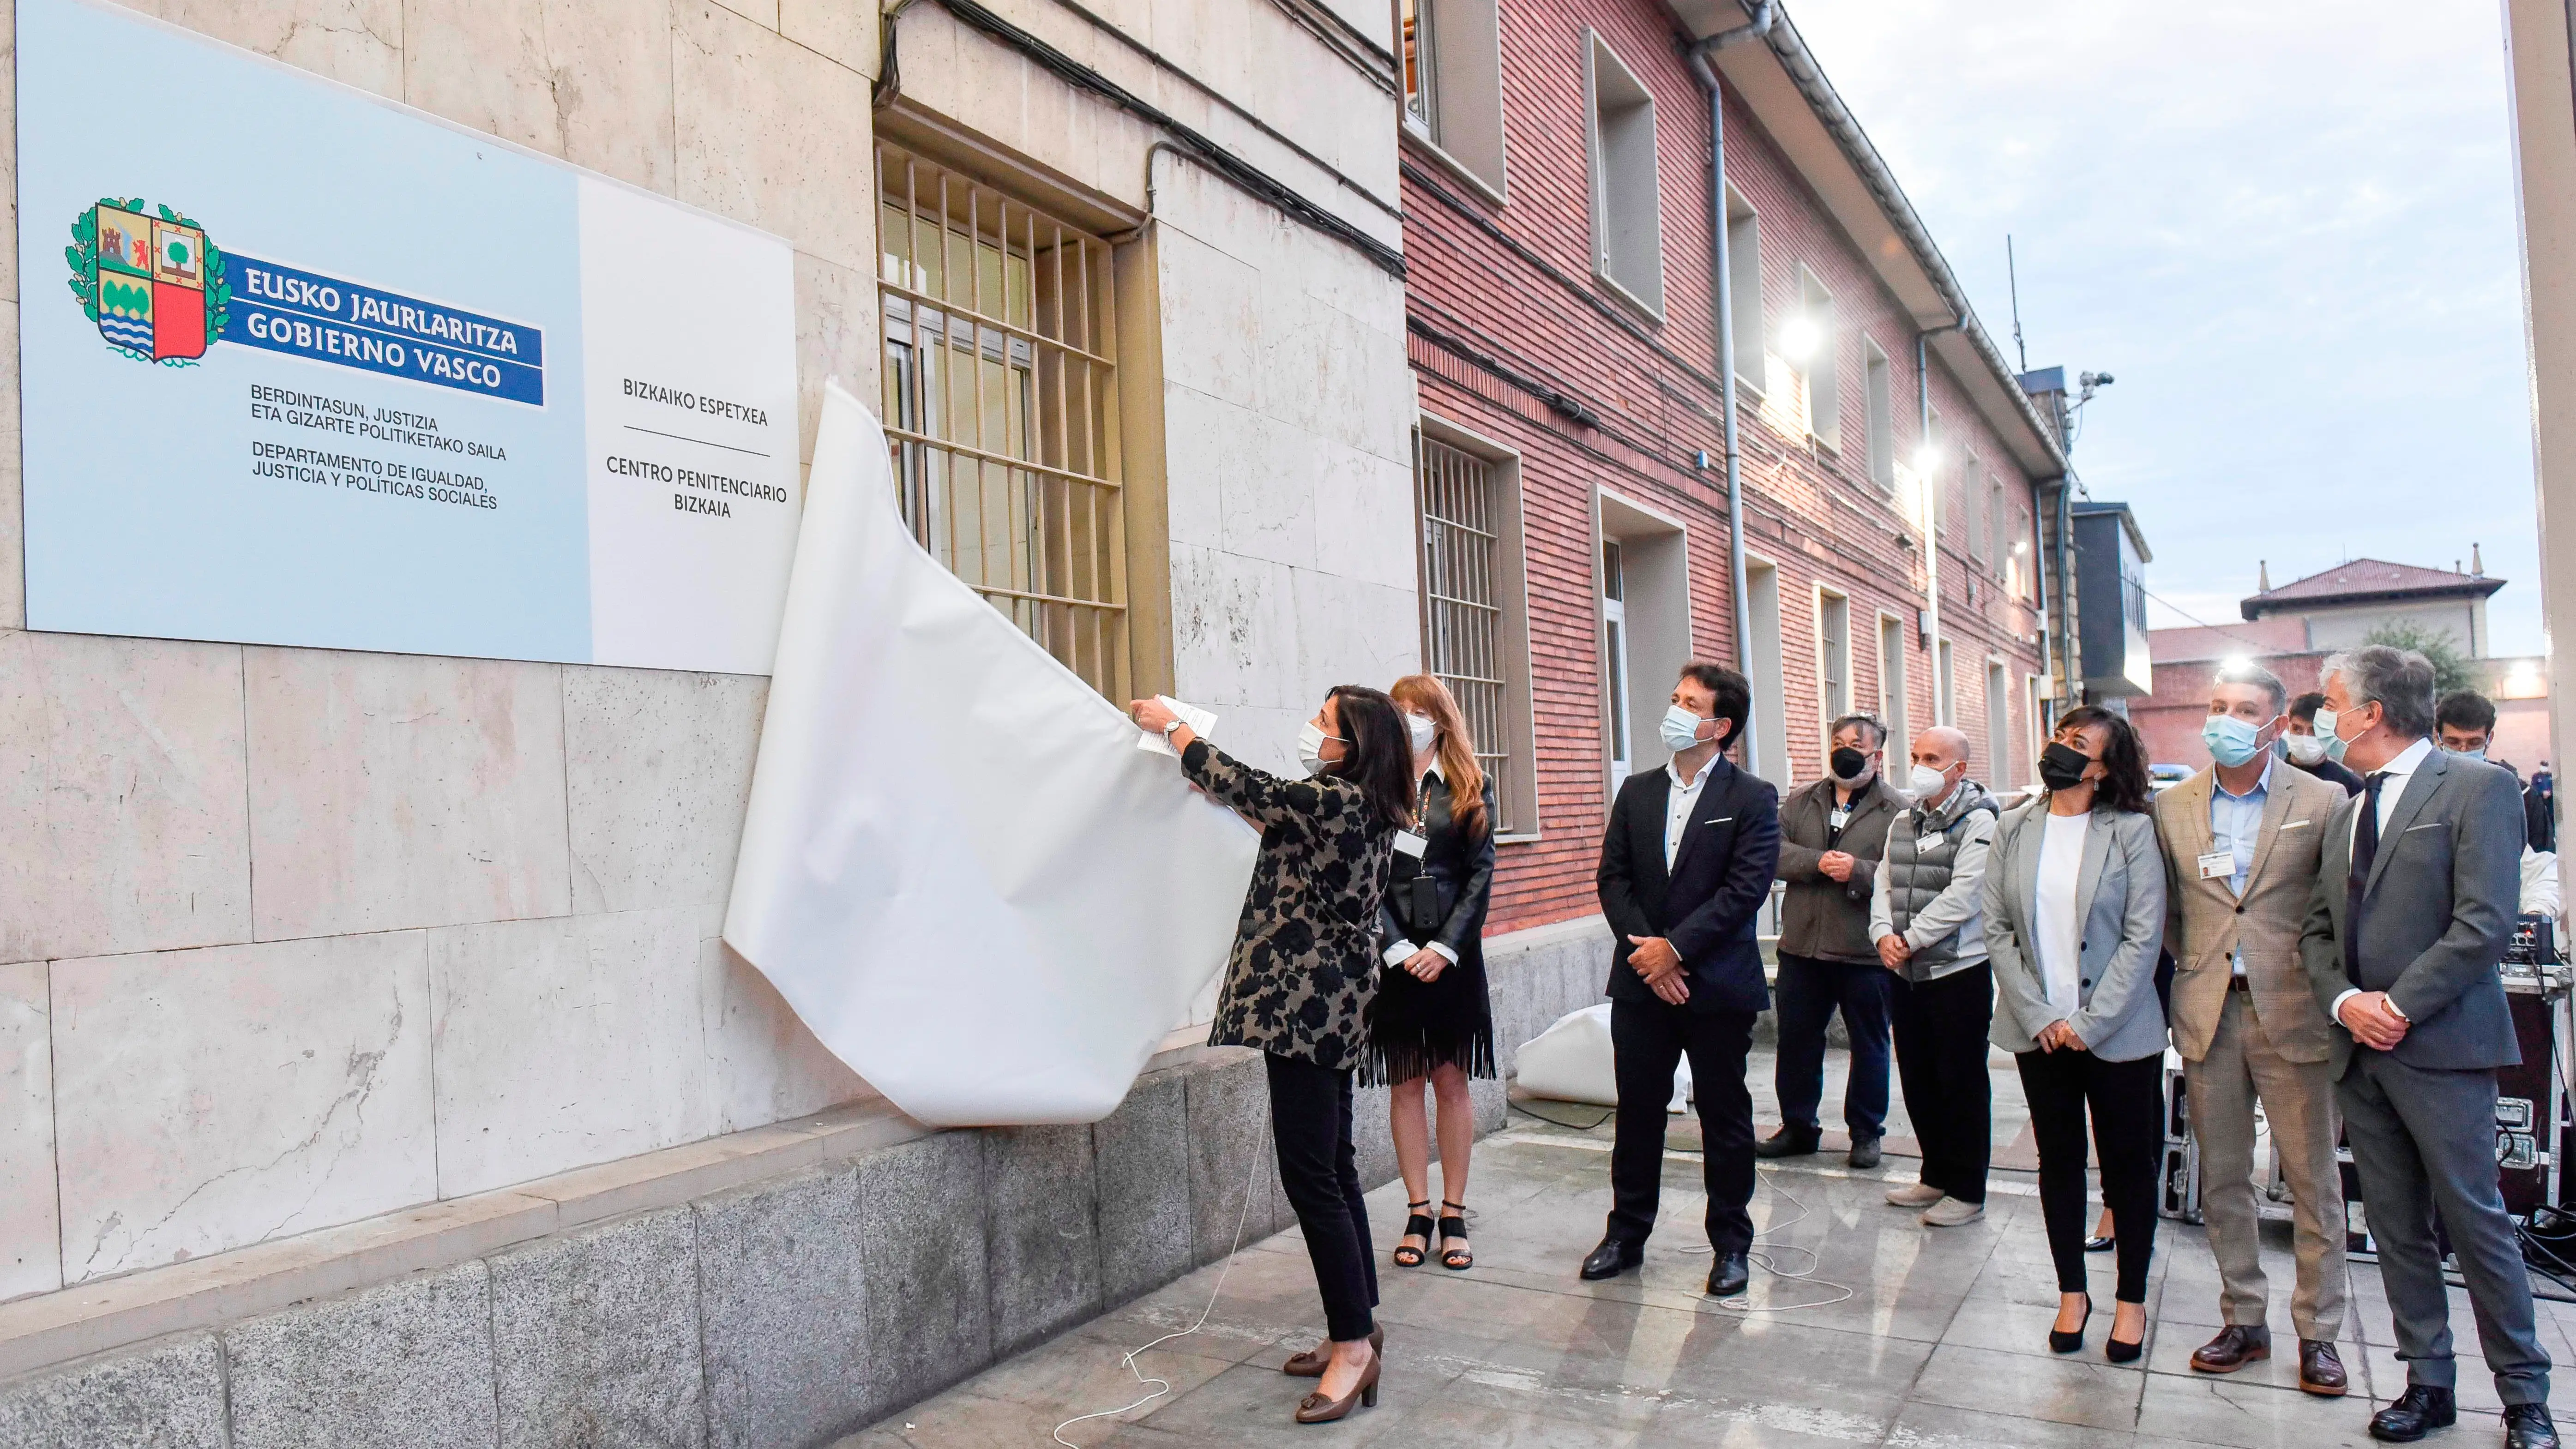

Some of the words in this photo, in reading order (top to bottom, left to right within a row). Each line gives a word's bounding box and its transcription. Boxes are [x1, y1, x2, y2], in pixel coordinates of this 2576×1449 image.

[245, 268, 340, 312] EUSKO
[350, 294, 517, 354] JAURLARITZA
[248, 313, 405, 367] GOBIERNO
[413, 348, 500, 387] VASCO
[251, 384, 368, 421] BERDINTASUN,
[373, 408, 438, 432] JUSTIZIA
[624, 378, 695, 409] BIZKAIKO
[700, 396, 768, 427] ESPETXEA
[252, 403, 282, 422] ETA
[287, 409, 355, 435] GIZARTE
[360, 422, 463, 453] POLITIKETAKO
[467, 442, 506, 461] SAILA
[252, 461, 327, 485] JUSTICIA
[331, 471, 341, 487] Y
[346, 474, 424, 499] POLÍTICAS
[428, 487, 497, 510] SOCIALES
[253, 441, 382, 475] DEPARTAMENTO
[387, 463, 407, 479] DE
[411, 467, 487, 493] IGUALDAD,
[607, 456, 673, 482] CENTRO
[678, 469, 787, 503] PENITENCIARIO
[674, 493, 731, 518] BIZKAIA
